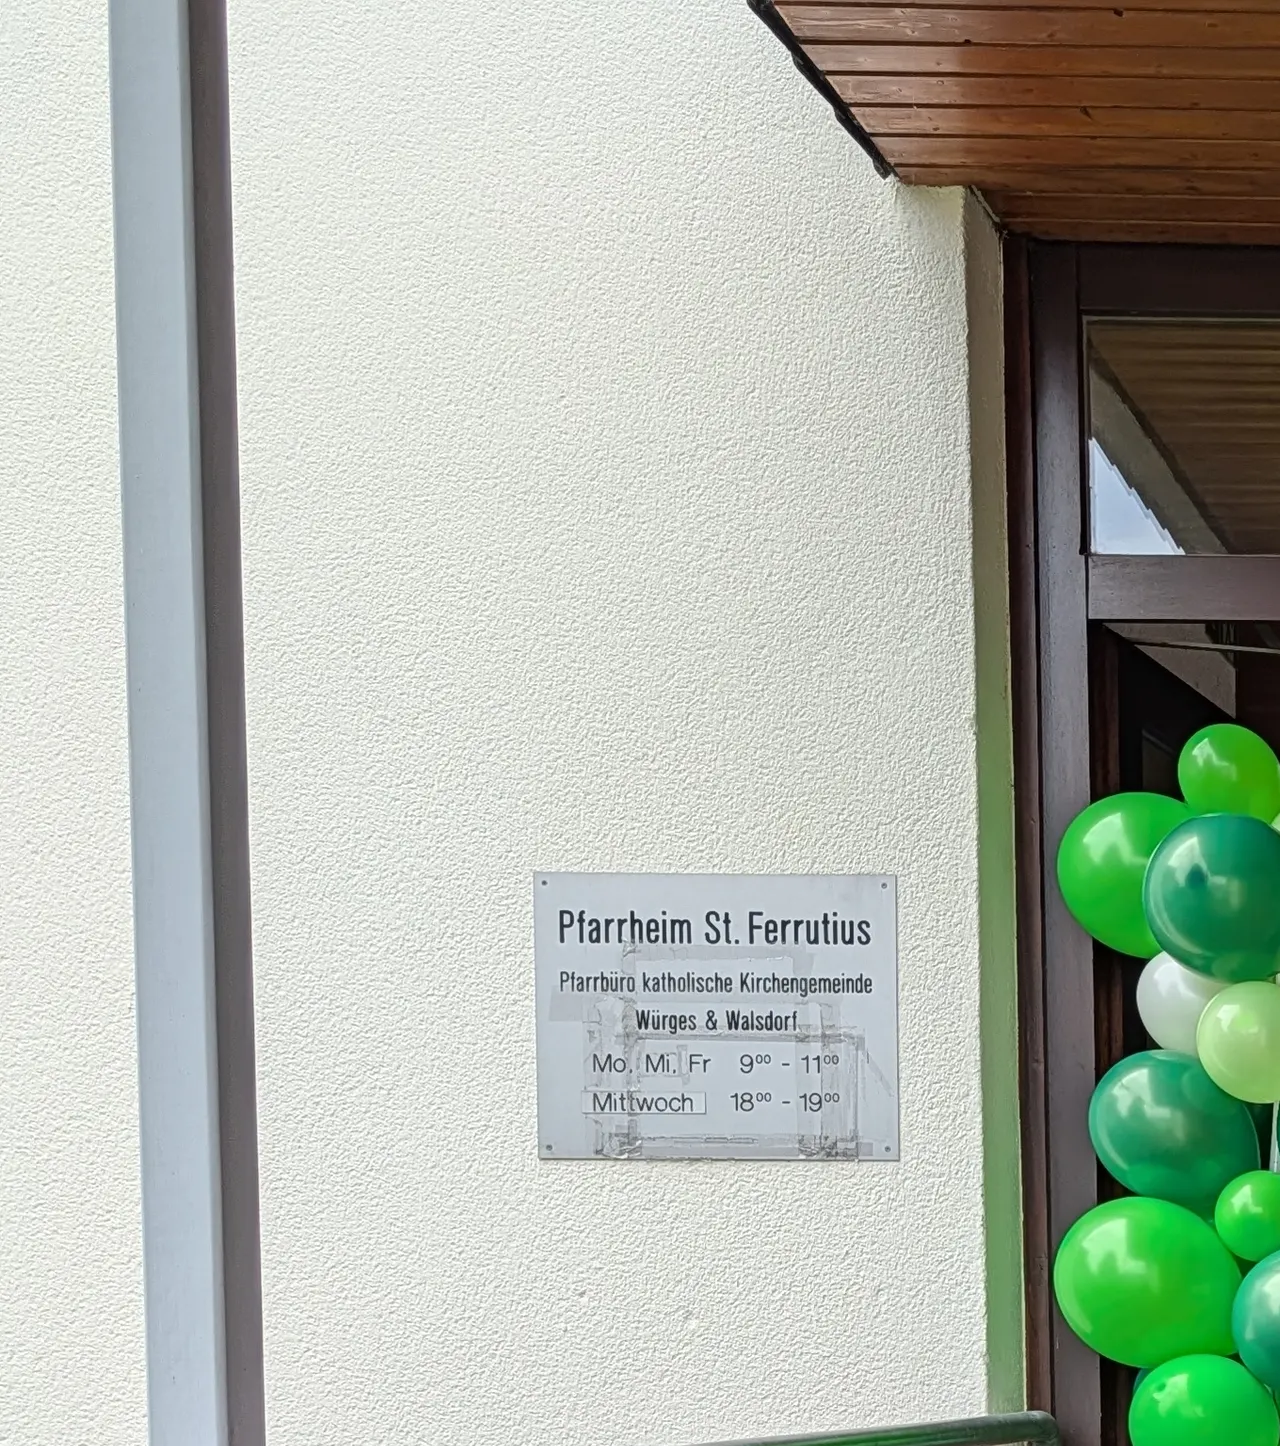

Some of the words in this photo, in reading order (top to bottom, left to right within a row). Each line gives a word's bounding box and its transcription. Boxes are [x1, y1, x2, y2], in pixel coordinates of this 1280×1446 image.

[559, 910, 692, 944] Pfarrheim
[704, 911, 740, 944] St.
[750, 912, 871, 945] Ferrutius
[560, 972, 636, 992] Pfarrbüro
[642, 972, 732, 993] katholische
[740, 972, 873, 997] Kirchengemeinde
[636, 1010, 697, 1034] Würges
[705, 1011, 718, 1030] &
[726, 1011, 798, 1031] Walsdorf
[689, 1054, 711, 1074] Fr
[592, 1093, 694, 1112] Mittwoch
